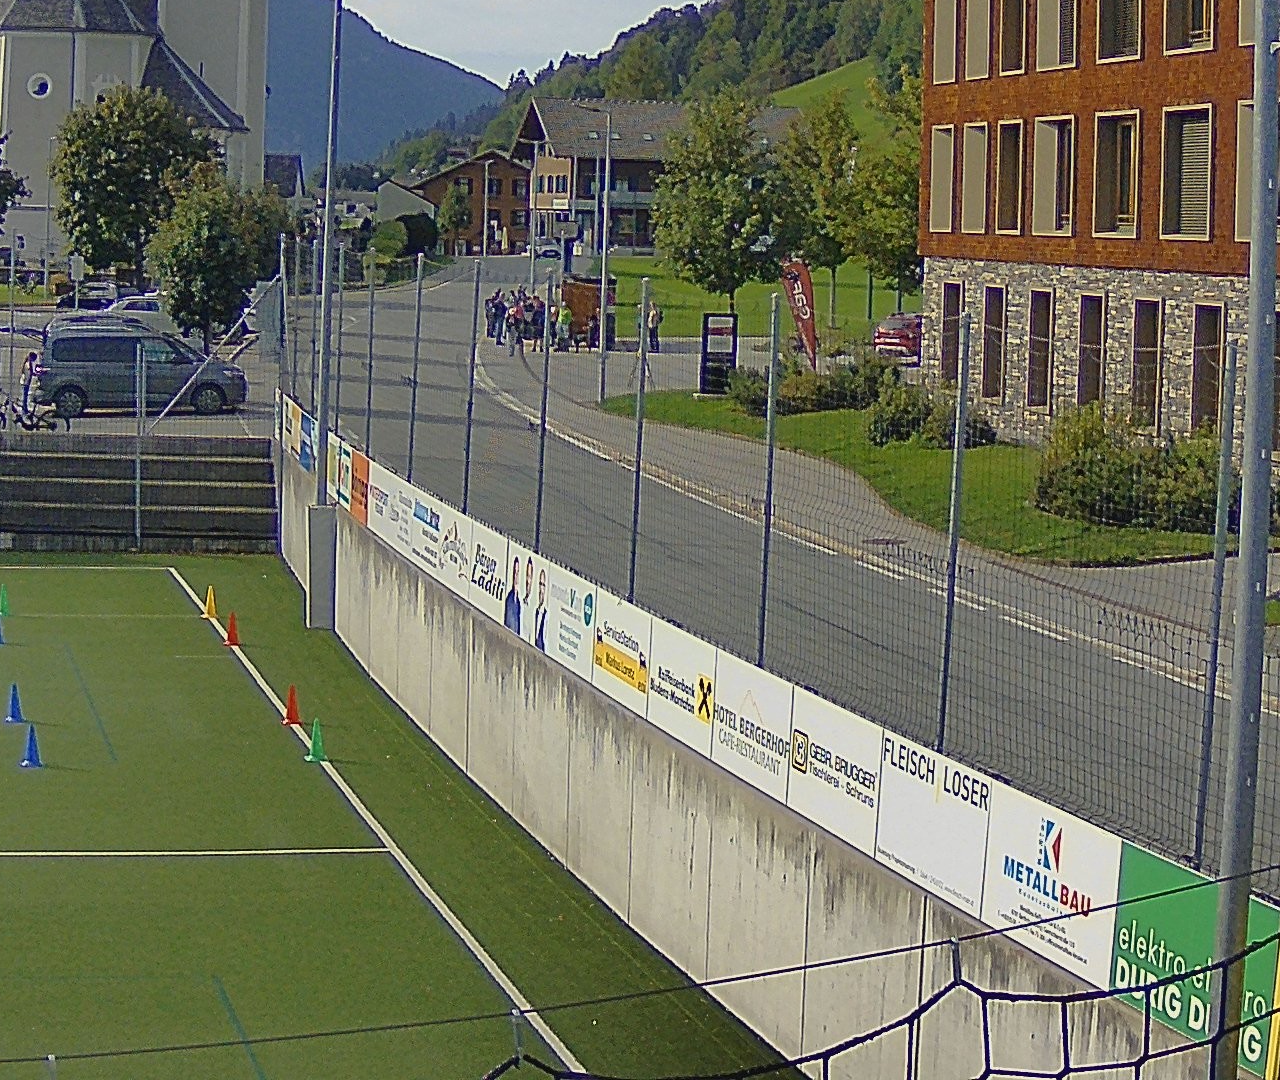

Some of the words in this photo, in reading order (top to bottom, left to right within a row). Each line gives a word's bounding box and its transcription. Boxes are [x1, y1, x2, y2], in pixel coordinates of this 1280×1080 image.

[712, 701, 738, 732] HOTEL
[883, 737, 936, 786] FLEISCH
[943, 765, 990, 812] LOSER
[1003, 855, 1091, 918] METALLBAU
[1118, 919, 1187, 978] elektro
